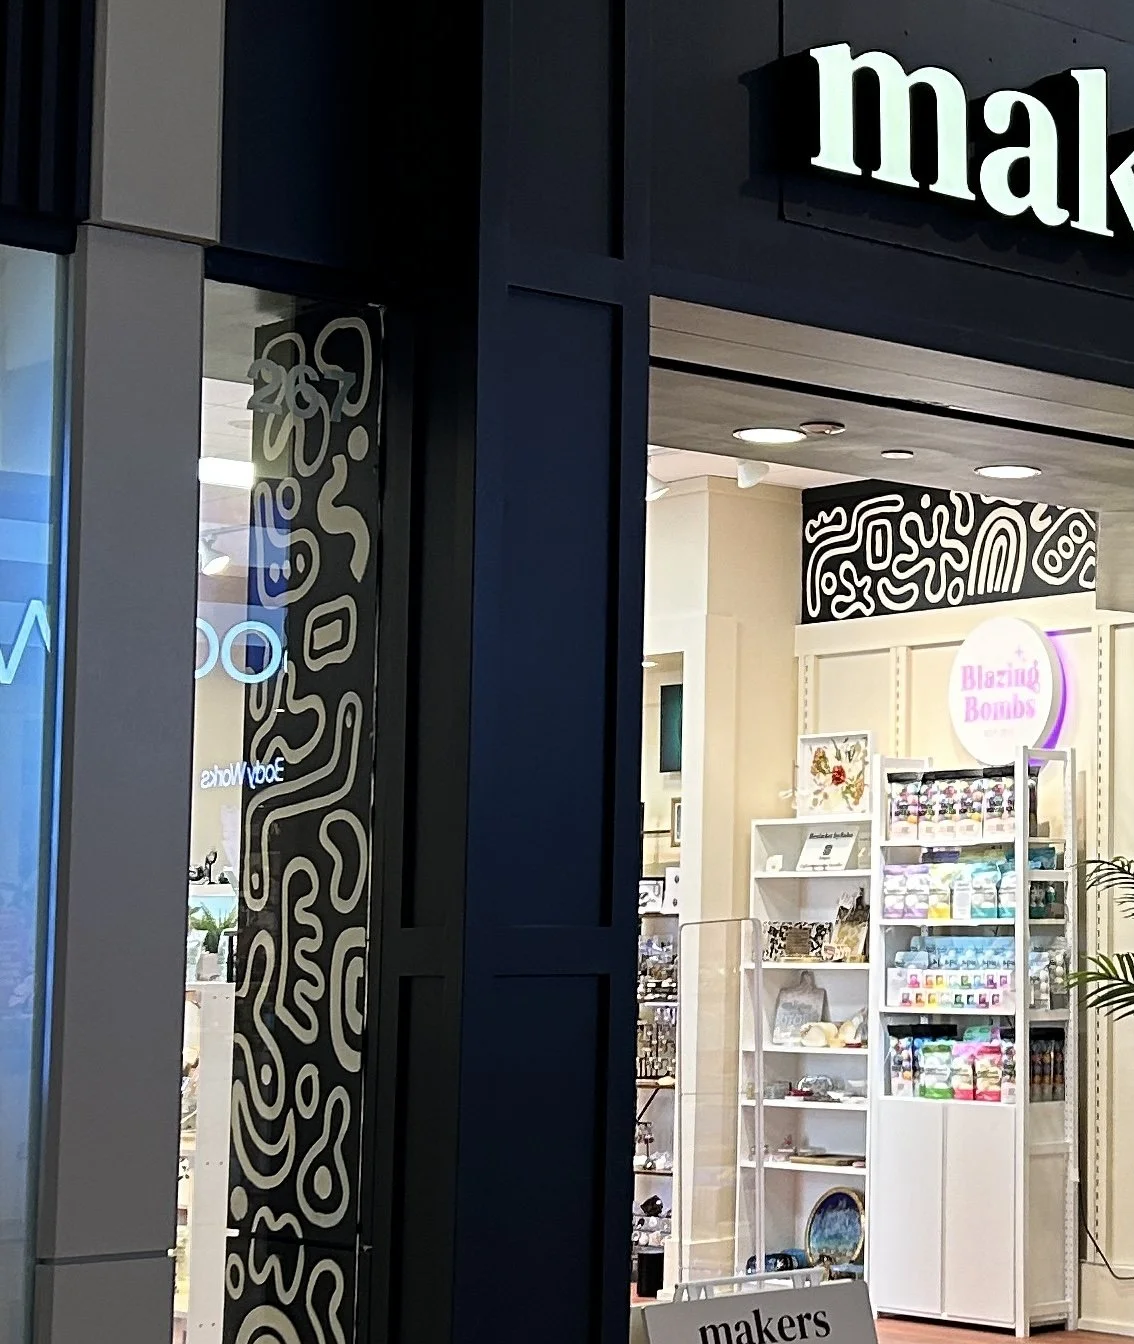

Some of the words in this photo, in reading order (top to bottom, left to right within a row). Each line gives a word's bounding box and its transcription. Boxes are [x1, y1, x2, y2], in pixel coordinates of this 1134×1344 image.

[247, 358, 356, 422] 267
[961, 659, 1041, 694] Blazing
[964, 693, 1037, 723] Bombs
